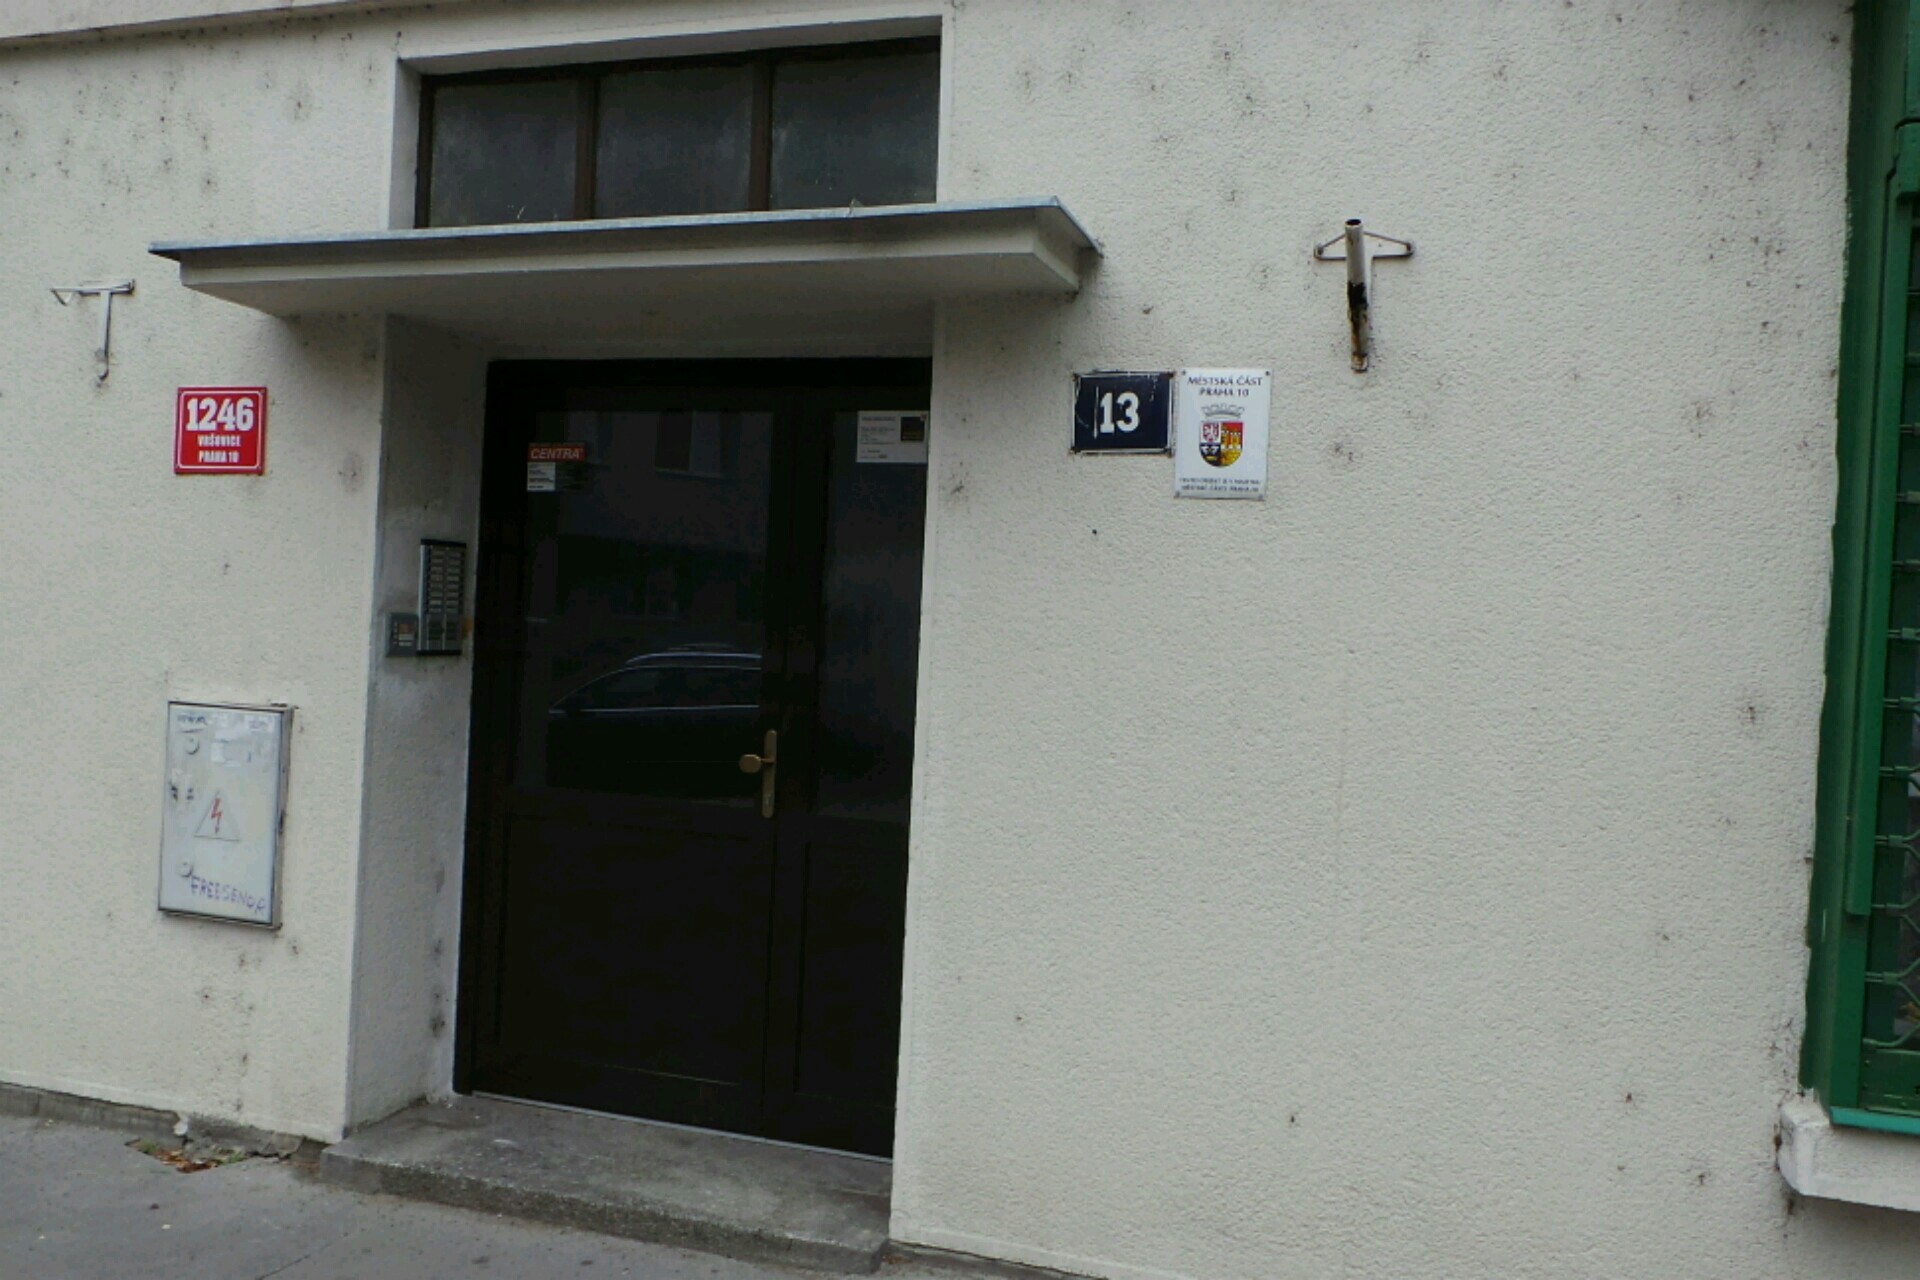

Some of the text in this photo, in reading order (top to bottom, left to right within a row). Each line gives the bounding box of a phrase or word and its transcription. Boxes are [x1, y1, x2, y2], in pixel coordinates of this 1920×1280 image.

[1236, 375, 1263, 387] ČÁST
[1200, 387, 1250, 398] PRAHA 10
[186, 397, 255, 432] 1246
[1099, 391, 1140, 434] 13
[199, 450, 228, 464] PRAHA
[530, 447, 581, 460] CENTRA
